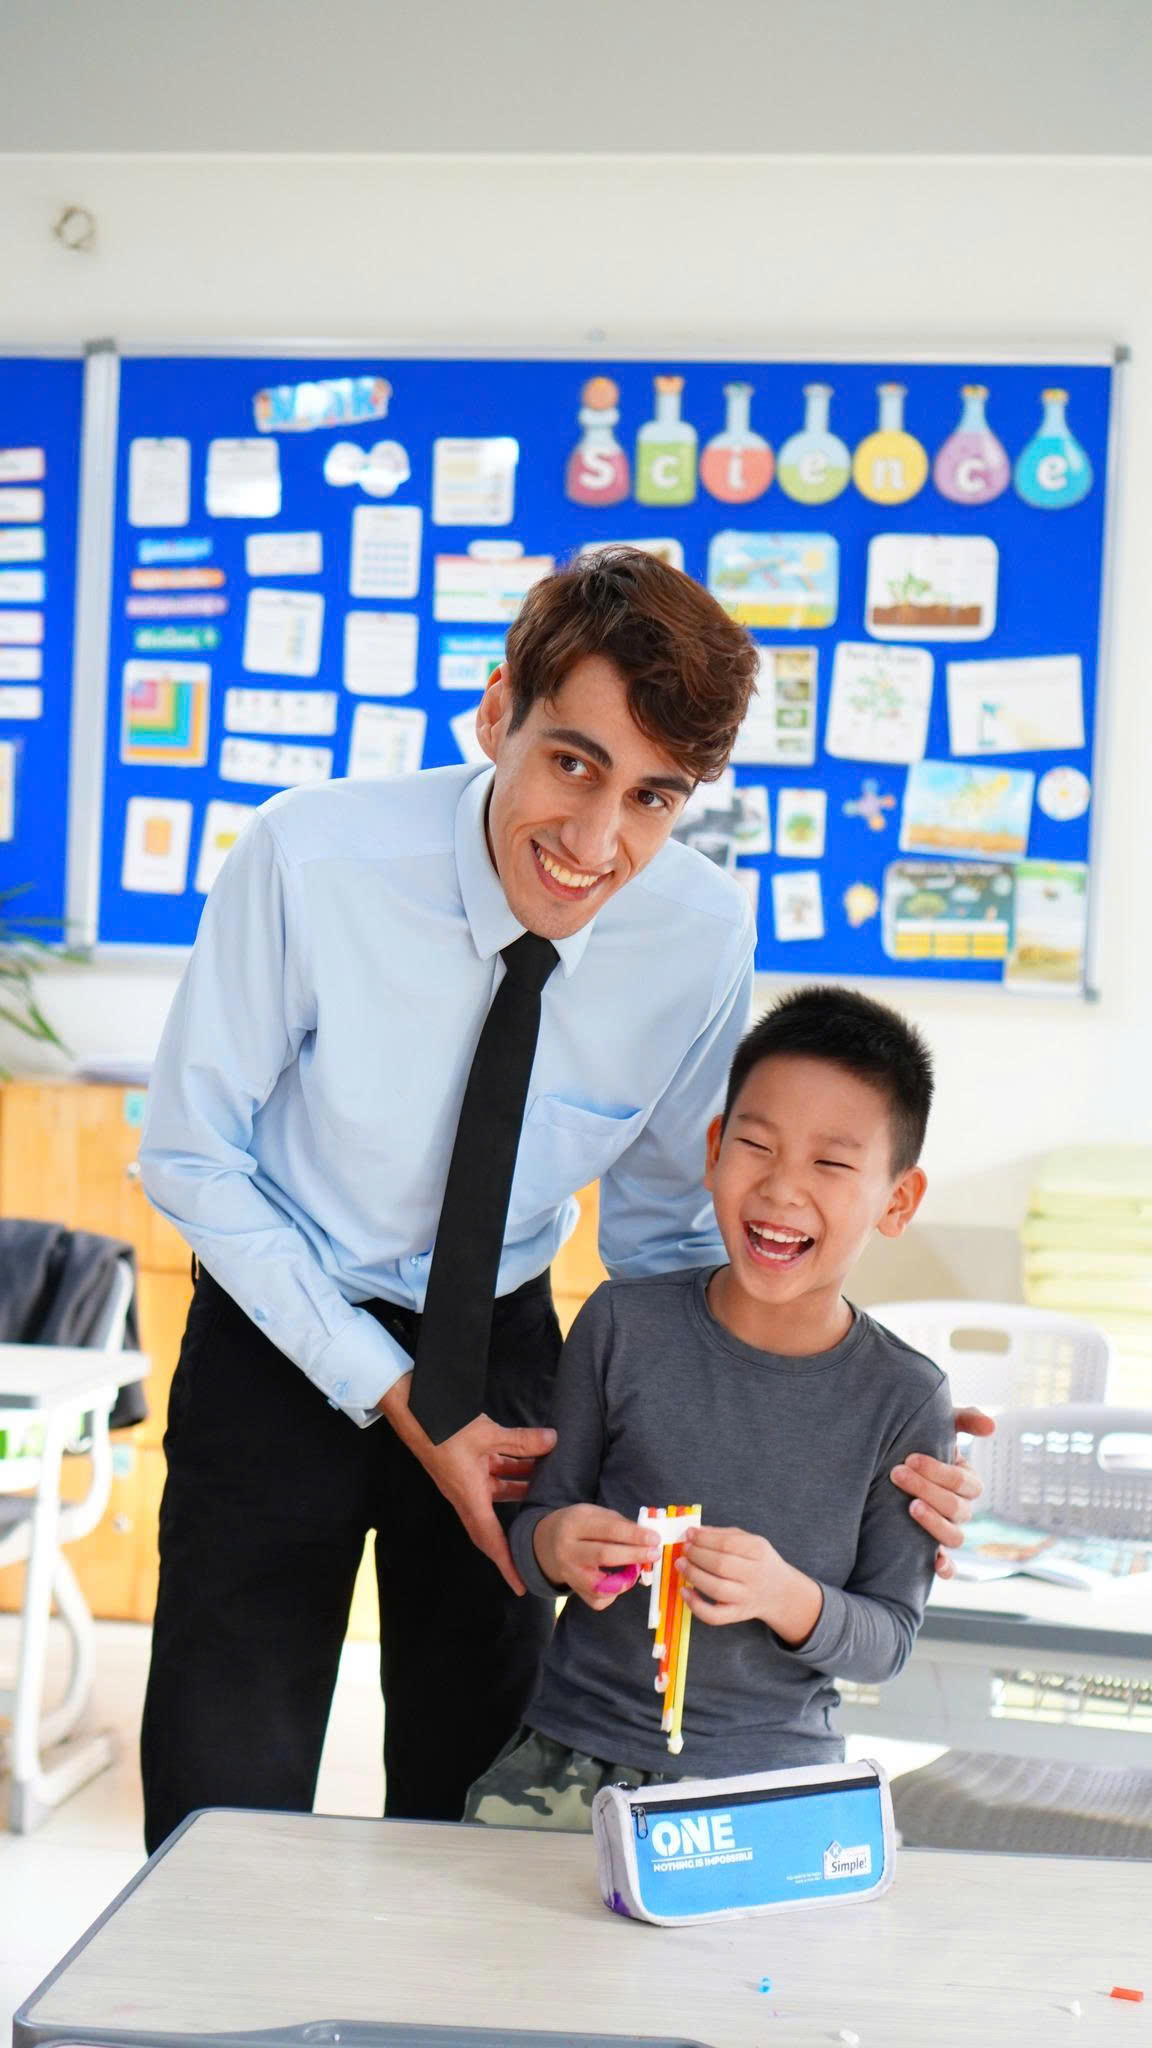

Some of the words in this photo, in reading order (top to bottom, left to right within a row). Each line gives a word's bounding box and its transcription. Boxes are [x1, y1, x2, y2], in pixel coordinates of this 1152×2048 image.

[579, 448, 1069, 491] Science
[651, 1814, 736, 1857] ONE
[653, 1859, 694, 1873] NOTHING
[695, 1857, 705, 1868] IS
[704, 1850, 753, 1867] IMPOSSIBLE
[831, 1856, 868, 1874] Simple!
